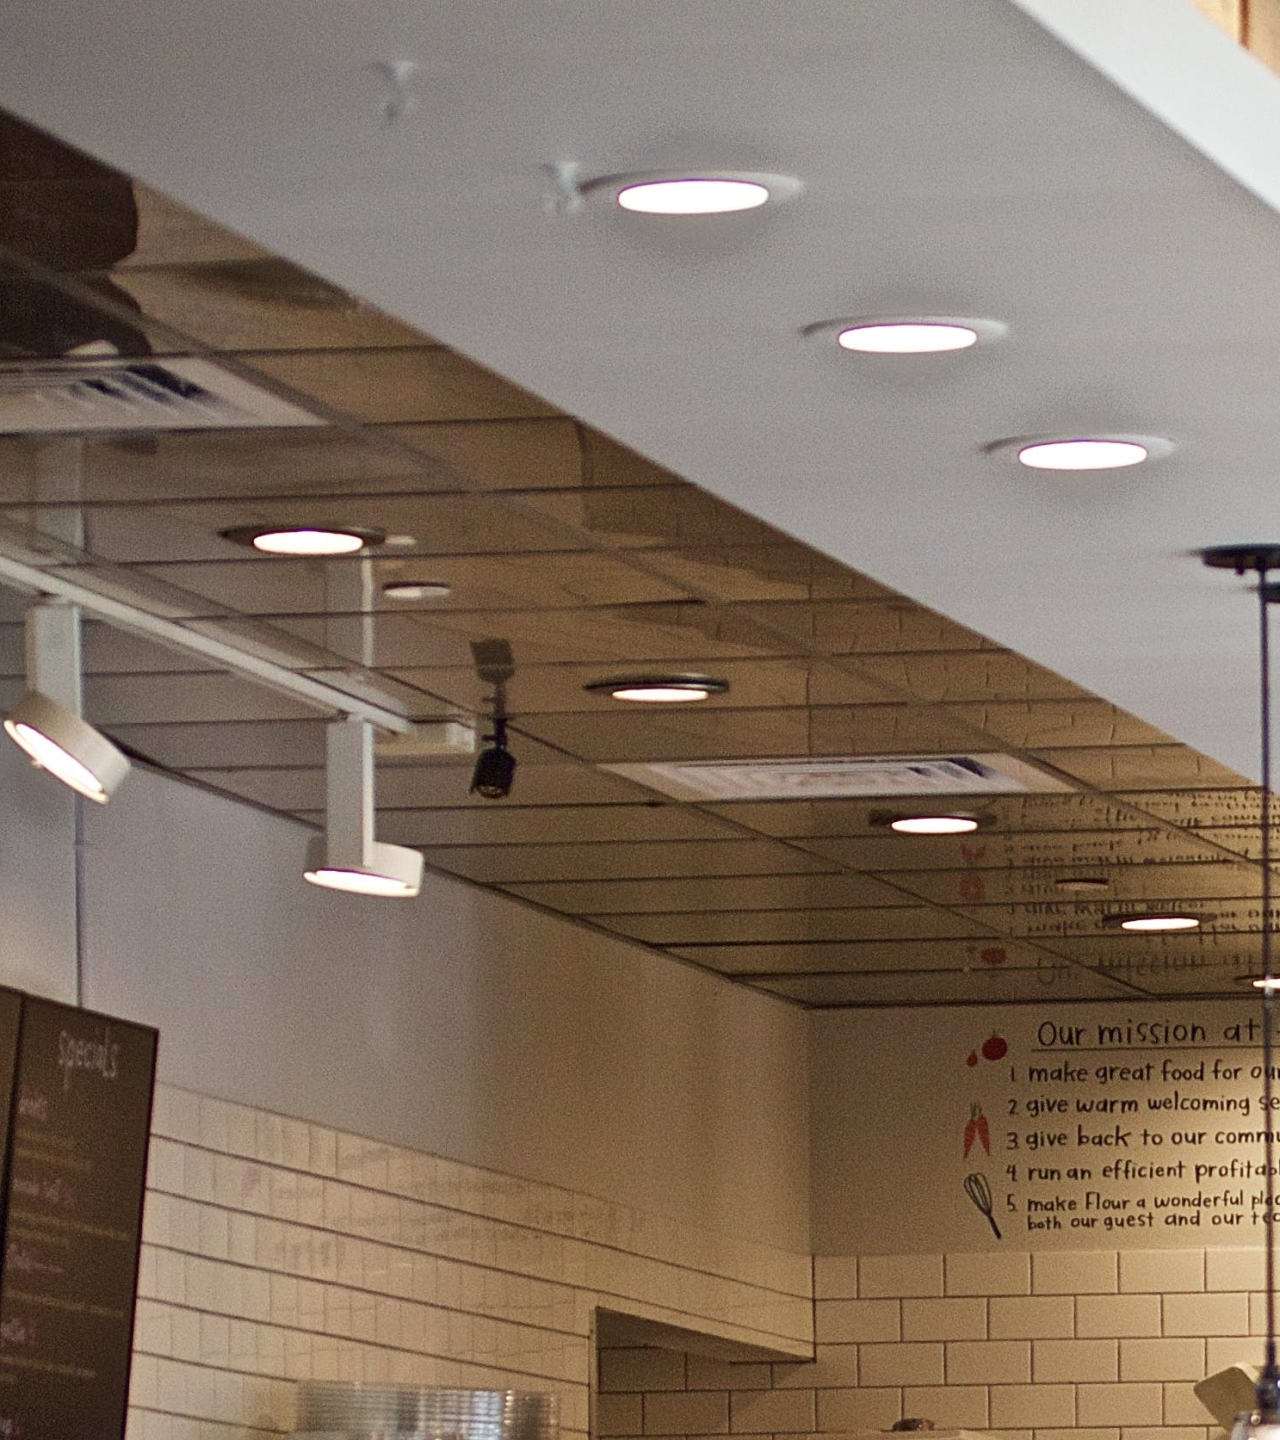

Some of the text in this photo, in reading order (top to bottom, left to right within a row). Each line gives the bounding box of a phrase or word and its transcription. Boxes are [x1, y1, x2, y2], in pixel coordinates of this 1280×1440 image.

[1037, 1020, 1087, 1047] Our
[1097, 1018, 1206, 1046] mission
[1223, 1017, 1262, 1042] at
[1009, 1066, 1017, 1083] 1
[1028, 1060, 1089, 1083] make
[1095, 1061, 1155, 1085] great
[1161, 1058, 1205, 1082] food
[1212, 1058, 1243, 1080] for
[1026, 1095, 1069, 1118] give
[1075, 1098, 1139, 1114] warm
[1147, 1089, 1251, 1117] welcoming
[1025, 1130, 1069, 1151] give
[1077, 1123, 1132, 1148] back
[1139, 1128, 1164, 1147] to
[1170, 1130, 1207, 1146] our
[1027, 1166, 1062, 1182] run
[1066, 1166, 1092, 1181] an
[1101, 1158, 1187, 1181] efficient
[1027, 1196, 1078, 1213] make
[1085, 1190, 1131, 1211] Flour
[1136, 1197, 1147, 1209] a
[1154, 1189, 1244, 1209] wonderful
[1027, 1215, 1062, 1232] both
[1070, 1216, 1099, 1229] our
[1103, 1211, 1154, 1231] guest
[1164, 1209, 1207, 1227] and
[1211, 1211, 1244, 1226] our
